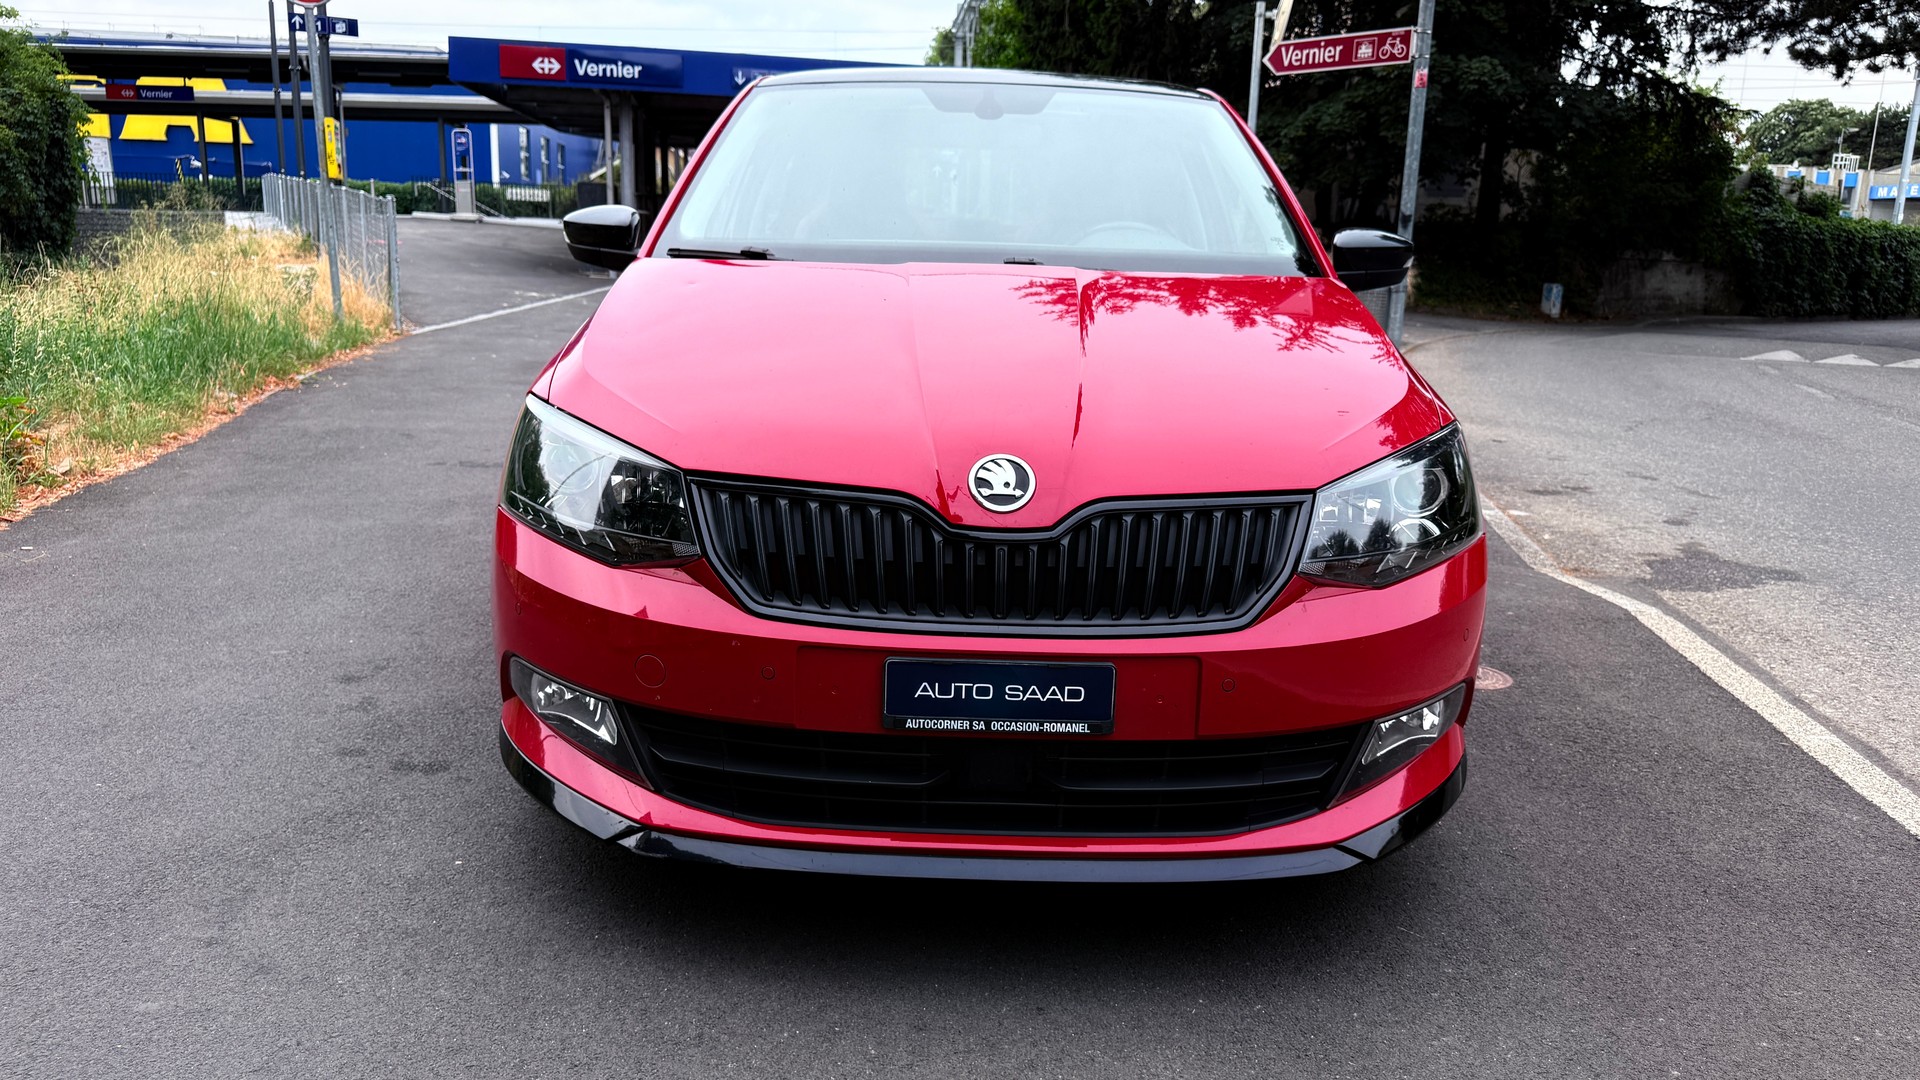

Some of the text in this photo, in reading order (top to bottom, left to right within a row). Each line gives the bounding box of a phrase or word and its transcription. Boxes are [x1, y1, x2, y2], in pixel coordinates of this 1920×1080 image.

[1281, 41, 1343, 67] Vernier
[574, 58, 643, 79] Vernier
[140, 89, 173, 98] Vernier
[1877, 185, 1919, 197] MAE
[914, 682, 1085, 702] AUTO SAAD
[905, 719, 1091, 733] AUTOCORNER SA OCCASION-ROMANEL
